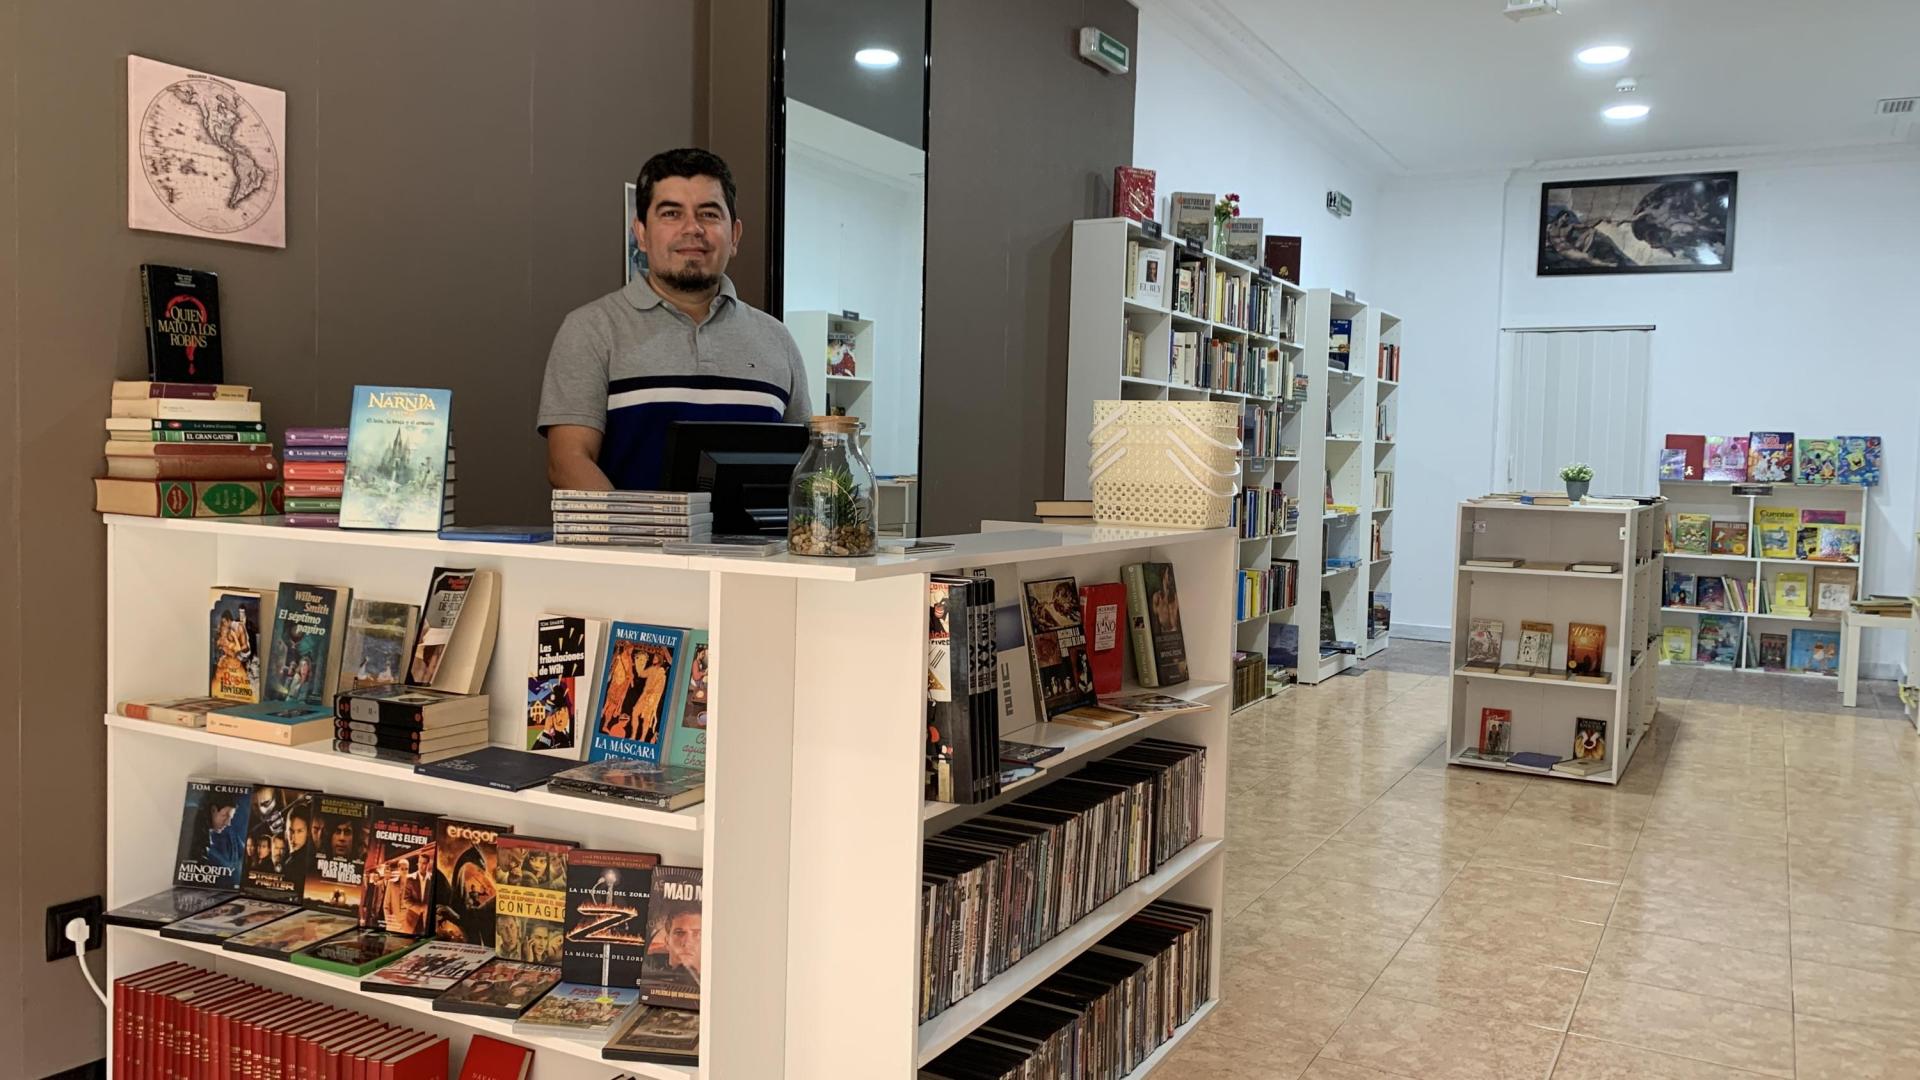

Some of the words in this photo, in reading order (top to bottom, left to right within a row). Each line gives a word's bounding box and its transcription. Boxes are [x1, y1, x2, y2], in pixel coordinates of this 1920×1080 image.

[170, 306, 205, 322] QUIEN
[158, 320, 188, 334] MATO
[189, 323, 197, 334] A
[199, 323, 217, 336] LOS
[170, 333, 208, 348] ROBINS
[367, 391, 436, 412] NARNIA
[295, 590, 323, 603] Wilbur
[303, 602, 329, 615] Smith
[279, 609, 288, 619] El
[288, 611, 321, 624] séptimo
[296, 624, 326, 636] papiro
[616, 628, 639, 640] MARY
[640, 631, 677, 646] RENAULT
[540, 643, 552, 654] Las
[540, 651, 585, 664] tribulaciones
[539, 665, 549, 676] de
[549, 664, 564, 675] Wilt
[594, 736, 607, 750] LA
[609, 738, 655, 760] MÁSCARA
[191, 783, 211, 791] TOM
[214, 785, 249, 795] CRUISE
[375, 830, 403, 842] OCEAN'S
[403, 835, 428, 845] ELEVEN
[179, 862, 236, 877] MINORITY
[317, 859, 329, 871] NO
[329, 860, 338, 872] ES
[338, 860, 355, 873] PAÍS
[178, 871, 219, 884] REPORT
[337, 870, 362, 885] VIEJOS
[663, 882, 694, 901] MAD
